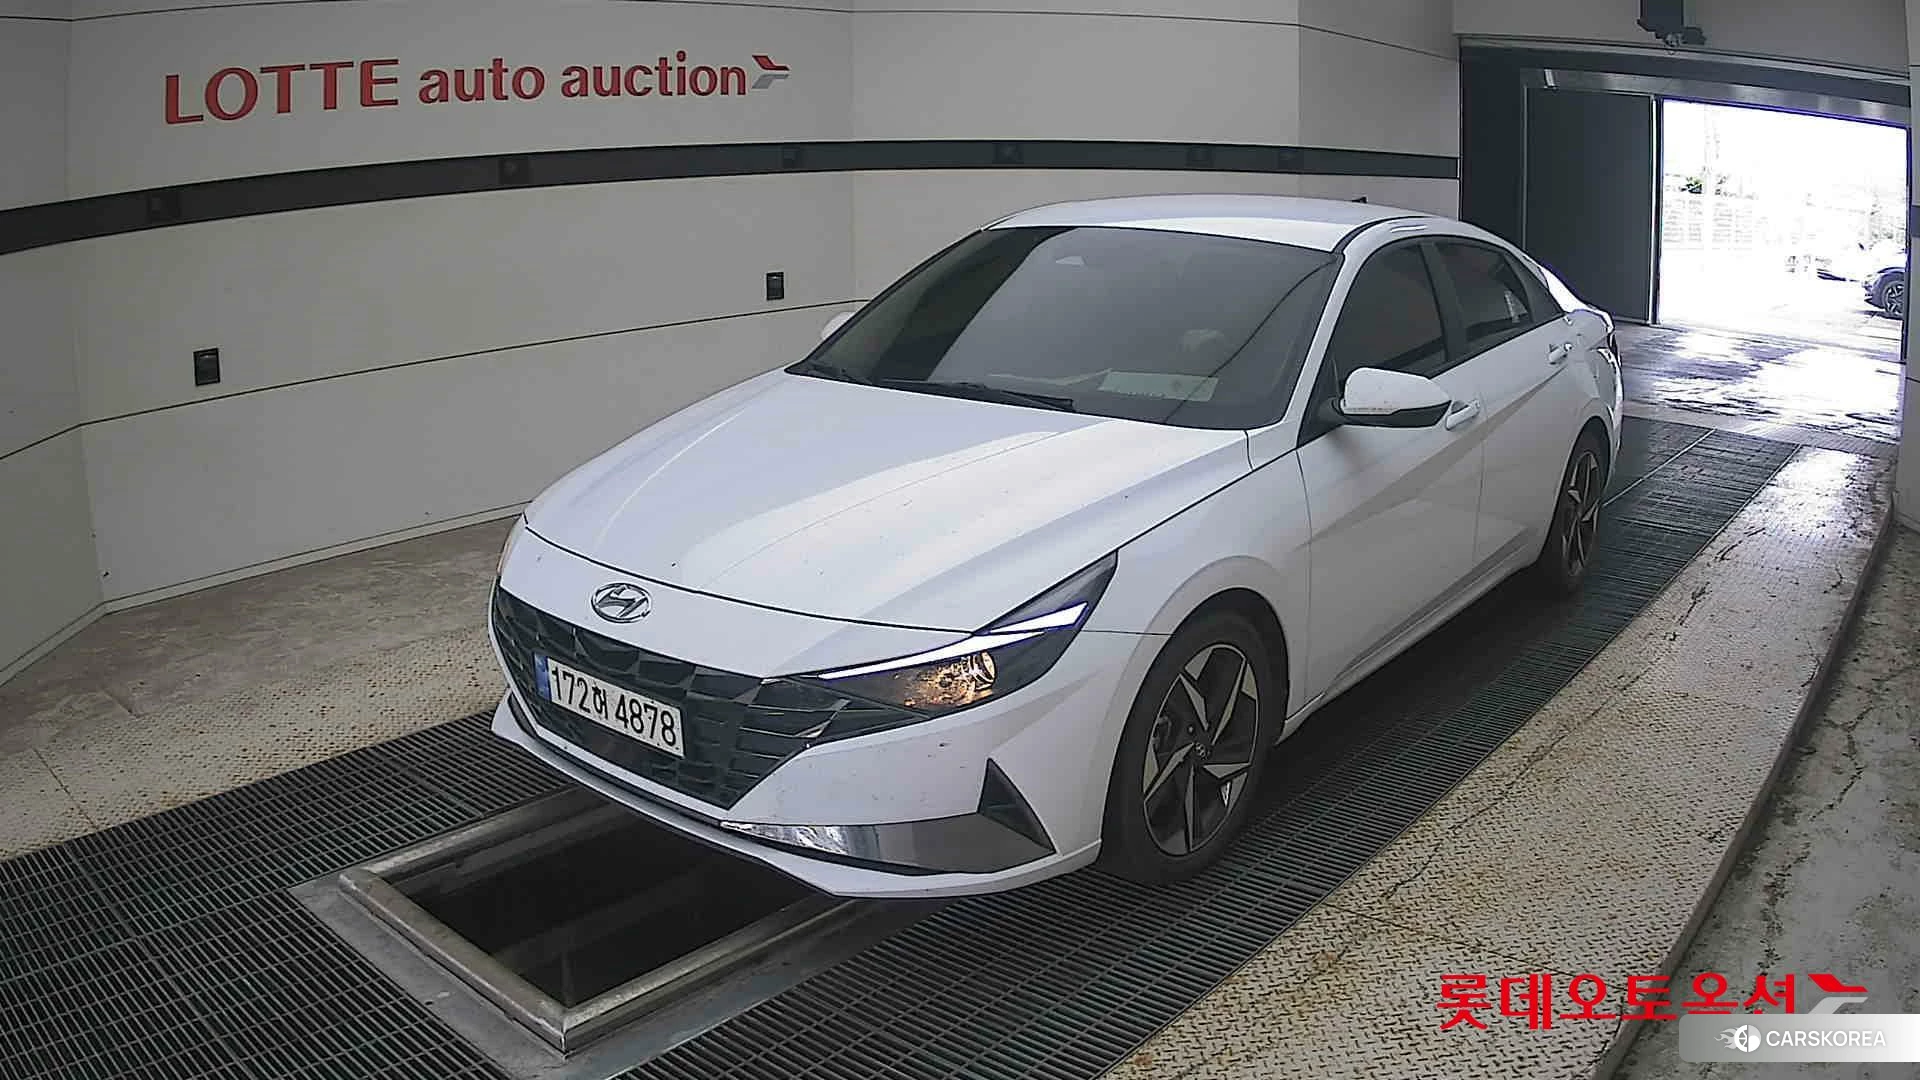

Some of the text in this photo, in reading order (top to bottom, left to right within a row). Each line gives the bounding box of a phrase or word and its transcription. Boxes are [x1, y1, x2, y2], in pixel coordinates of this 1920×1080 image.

[165, 50, 748, 125] LOTTE auto auction
[615, 694, 677, 747] 4878
